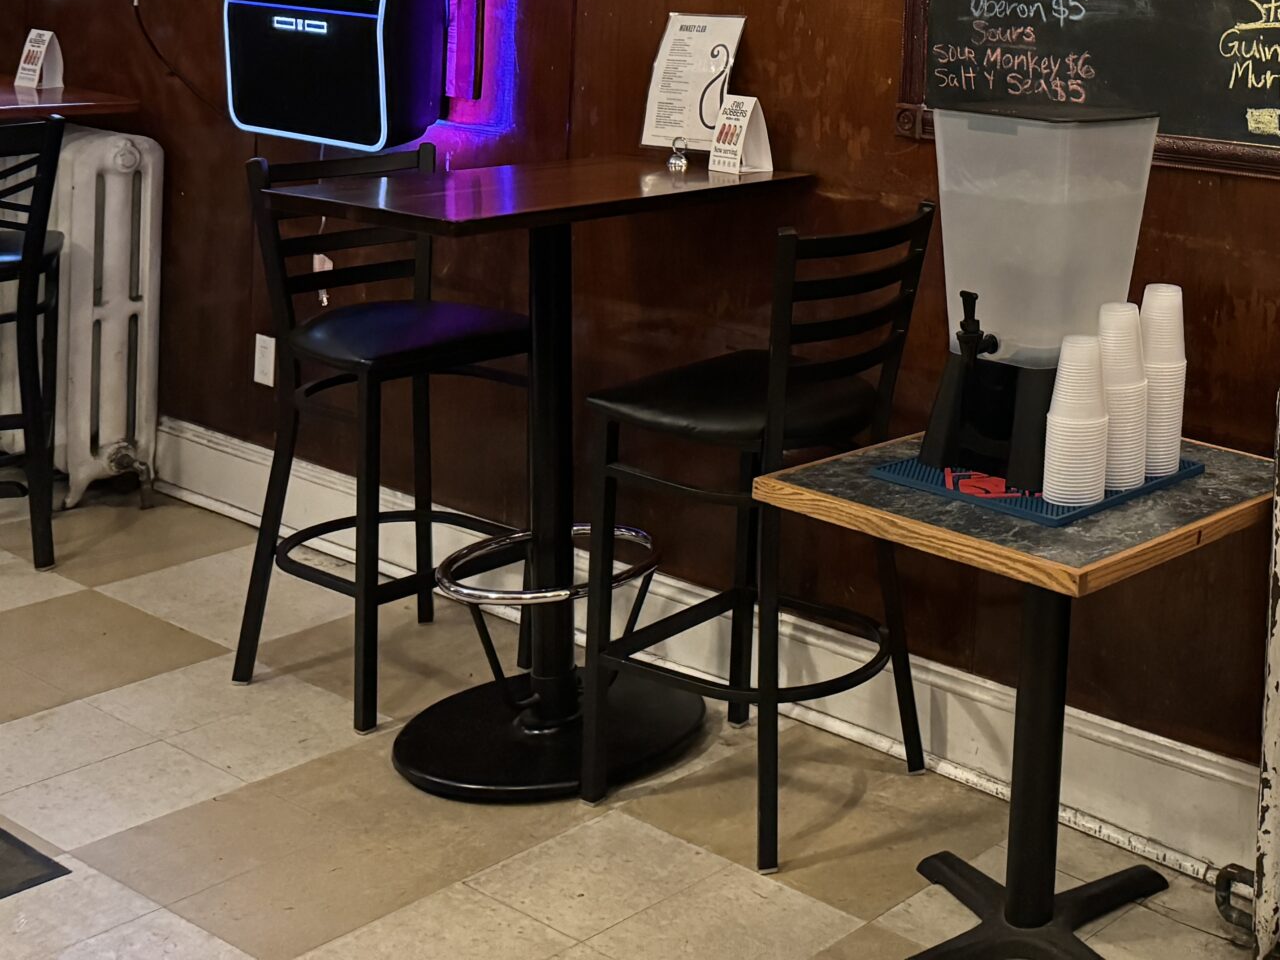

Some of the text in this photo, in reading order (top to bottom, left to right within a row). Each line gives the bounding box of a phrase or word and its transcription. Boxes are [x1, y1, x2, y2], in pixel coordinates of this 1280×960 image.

[971, 20, 1036, 44] Sours
[984, 47, 1060, 82] Monkey
[1065, 51, 1095, 78] $6
[1051, 76, 1086, 103] $5
